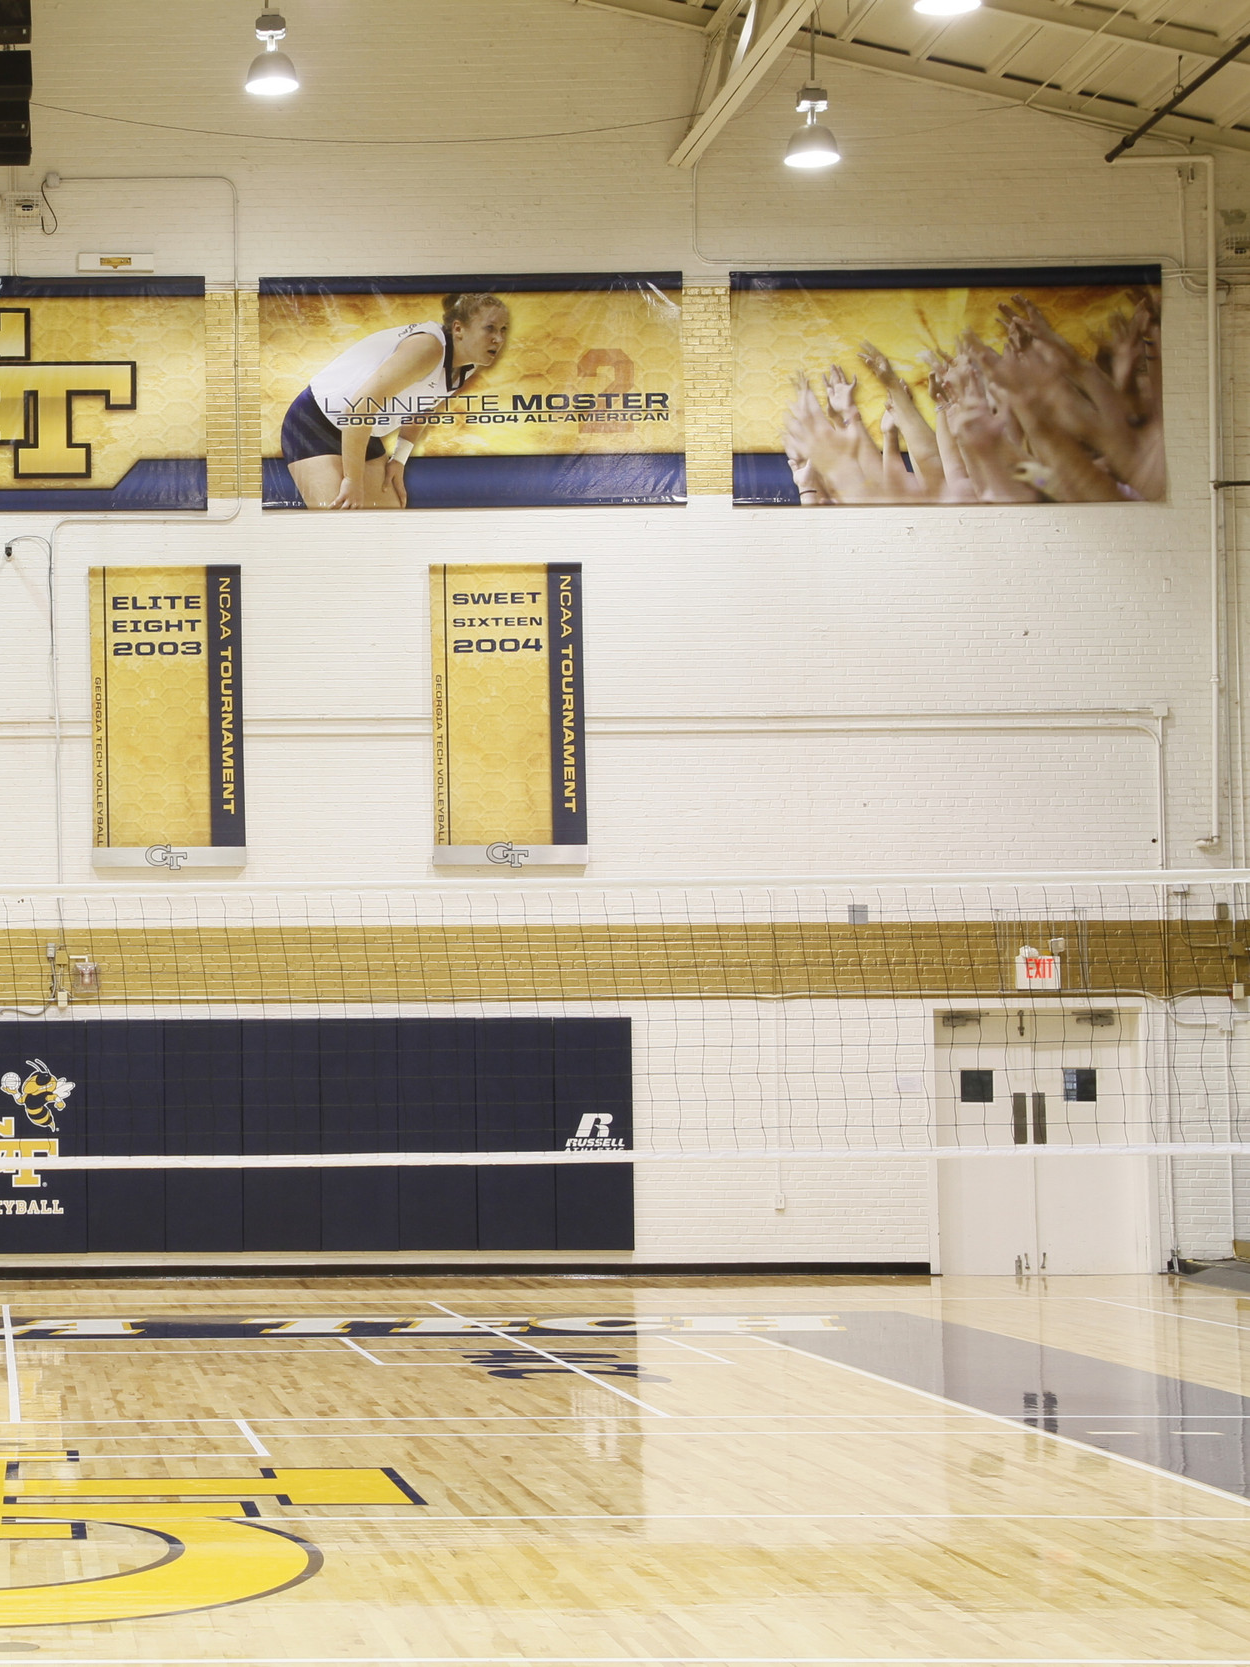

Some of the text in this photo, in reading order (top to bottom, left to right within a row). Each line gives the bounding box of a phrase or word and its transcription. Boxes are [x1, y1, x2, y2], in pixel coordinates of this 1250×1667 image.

[577, 348, 634, 434] 2
[324, 393, 669, 414] LYNNETTE MOSTER
[336, 412, 669, 426] 2002 2003 2004 ALL-AMERICAN
[112, 596, 201, 610] ELITE
[452, 592, 541, 605] SWEET
[112, 619, 201, 633] EIGHT
[453, 617, 543, 627] SIXTEEN
[113, 641, 202, 656] 2003
[453, 638, 543, 653] 2004
[219, 577, 235, 814] NCAA TOURNAMENT
[559, 575, 576, 813] NCAA TOURNAMENT
[95, 736, 103, 768] TECH
[435, 674, 445, 845] GEORGIA TECH VOLLEYBALL
[96, 771, 104, 847] VOLLEYBALL
[145, 844, 188, 870] GT
[486, 842, 529, 868] GT
[1026, 957, 1054, 979] EXIT
[565, 1138, 625, 1147] RUSSELL
[241, 1315, 849, 1333] TECH
